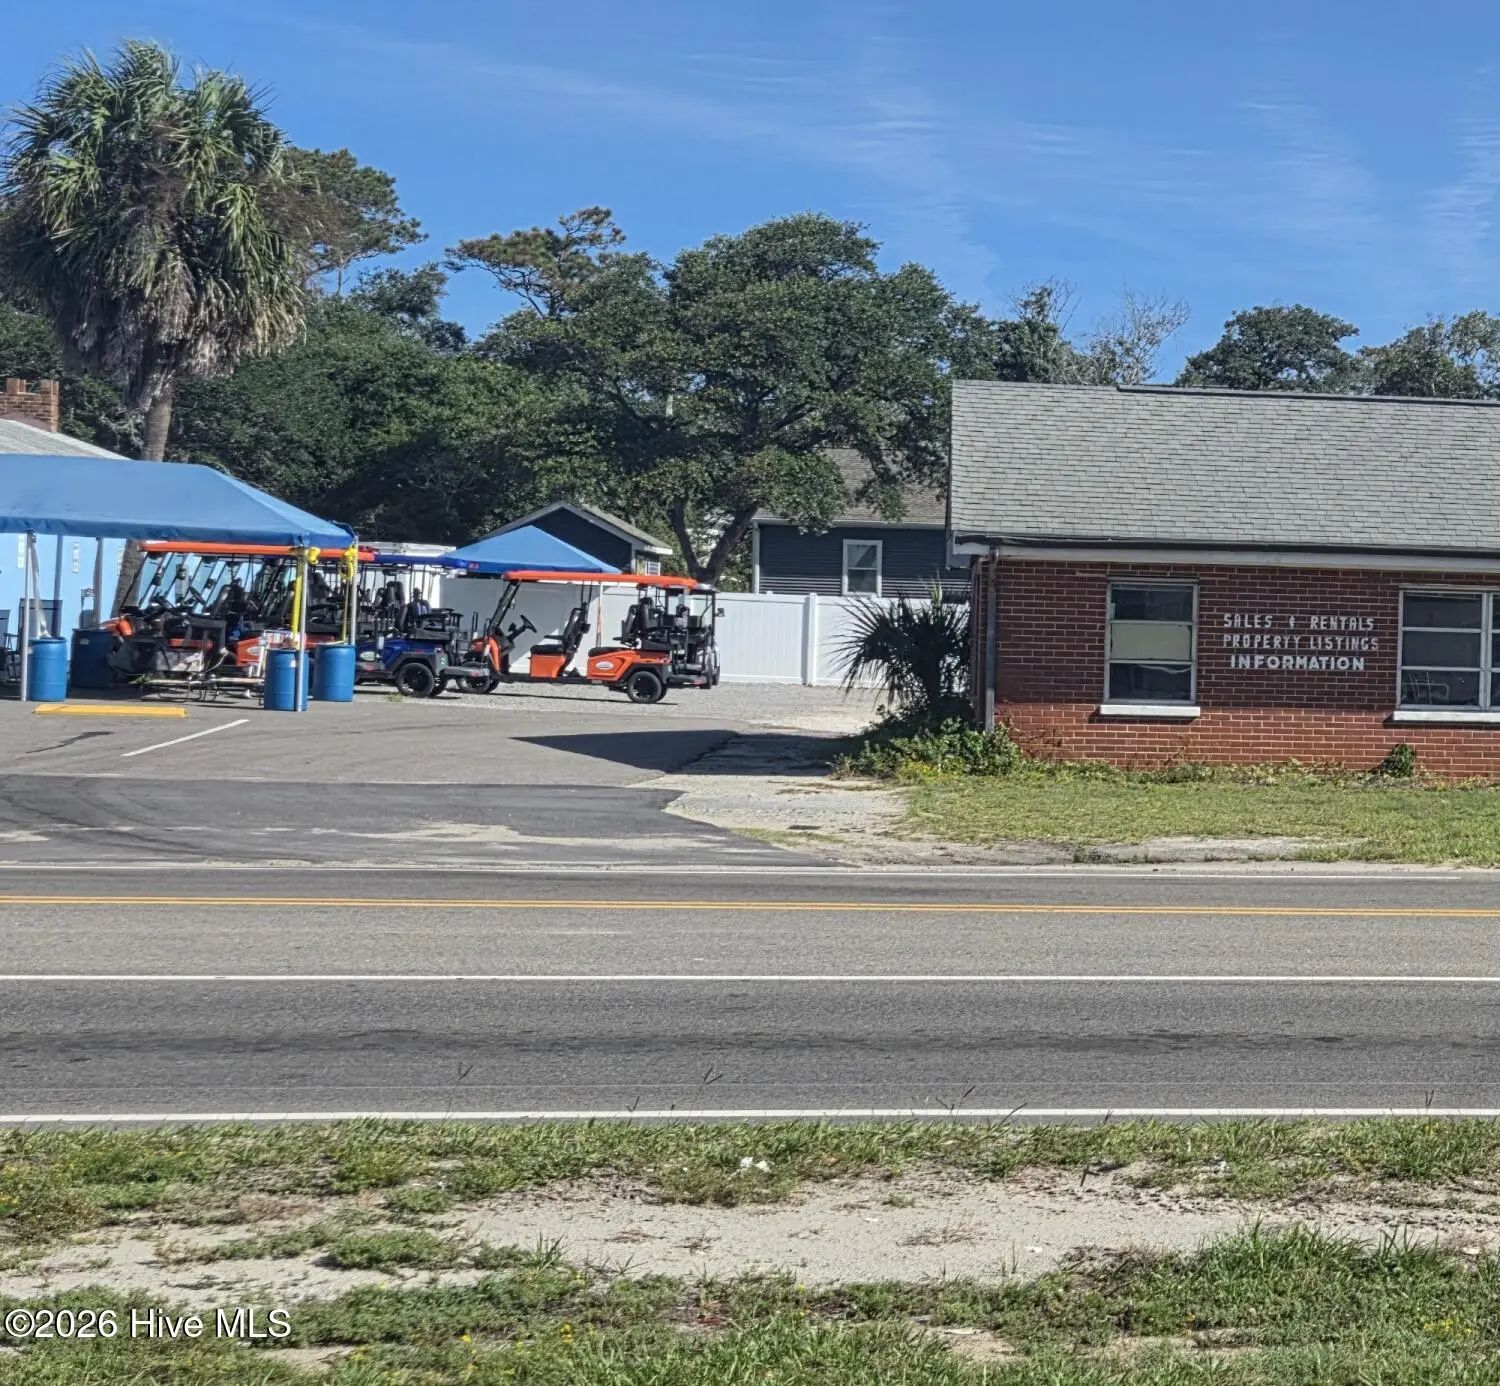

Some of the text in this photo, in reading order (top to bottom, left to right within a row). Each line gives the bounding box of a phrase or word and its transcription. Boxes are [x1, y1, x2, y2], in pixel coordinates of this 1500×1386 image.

[1223, 613, 1273, 628] SALES
[1310, 616, 1375, 631] RENTALS
[1223, 634, 1379, 650] PROPERTY LISTINGS
[1230, 654, 1365, 670] INFORMATION
